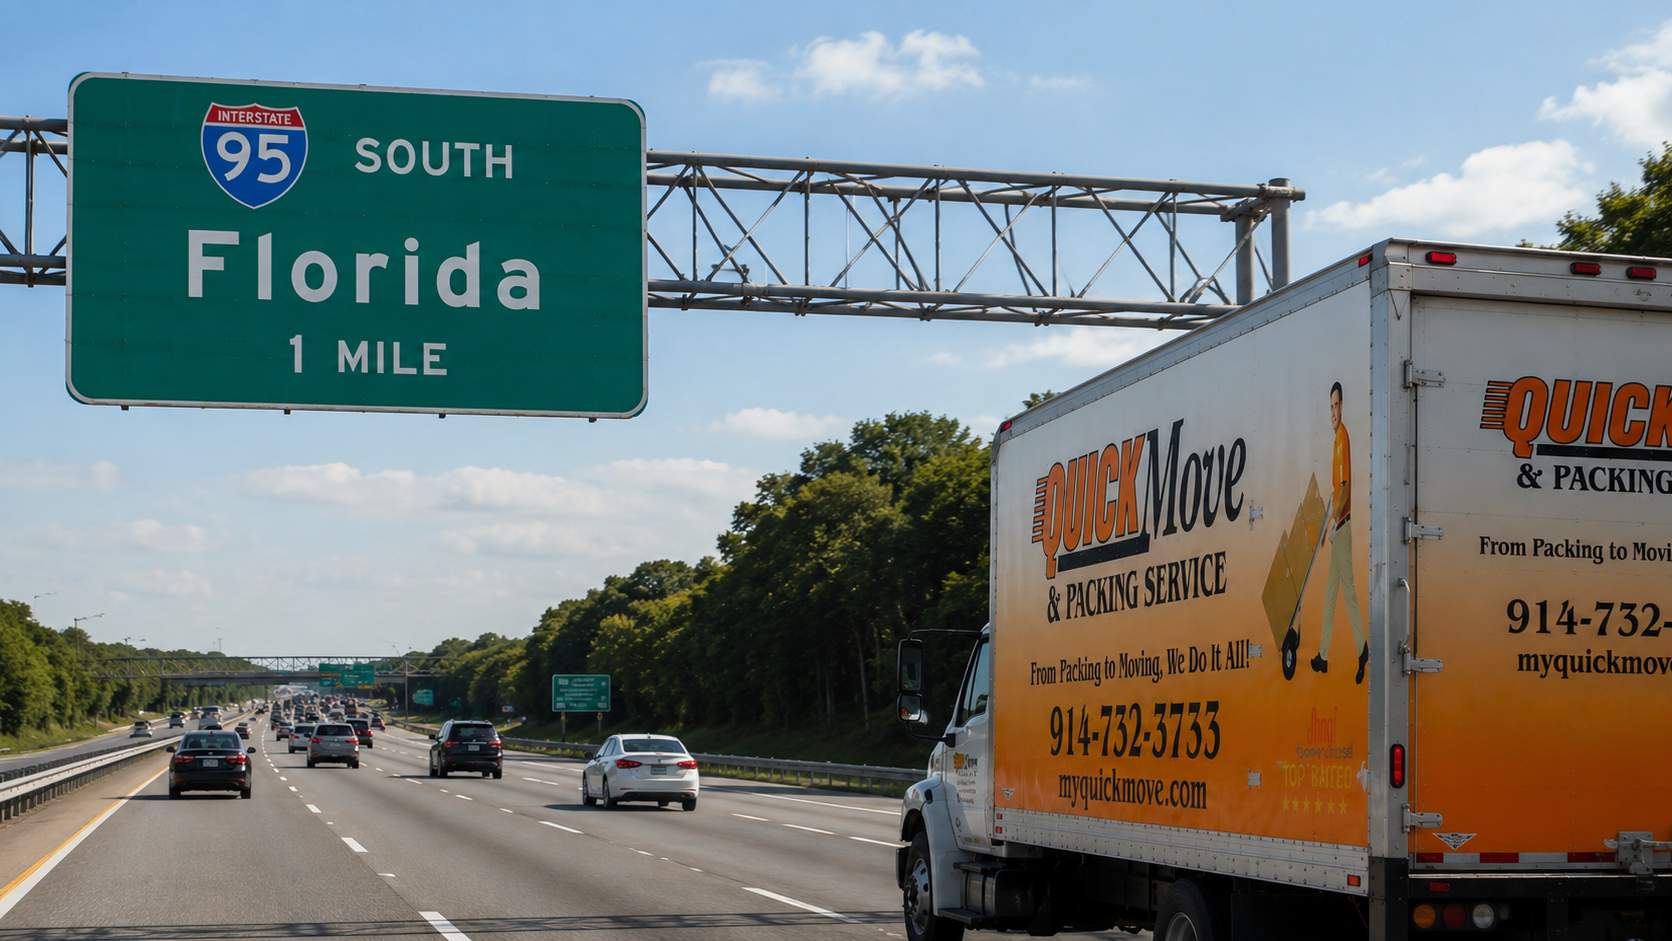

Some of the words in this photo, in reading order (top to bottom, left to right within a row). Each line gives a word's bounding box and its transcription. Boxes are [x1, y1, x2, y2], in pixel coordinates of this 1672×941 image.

[218, 110, 292, 125] INTERSTATE
[216, 131, 291, 184] 95
[355, 137, 513, 179] SOUTH
[188, 229, 541, 310] Florida
[289, 334, 302, 373] 1
[338, 340, 448, 376] MILE
[1516, 463, 1543, 489] &
[1552, 465, 1672, 495] PACKING
[1479, 536, 1527, 557] From
[1532, 538, 1604, 565] Packing
[1609, 541, 1628, 560] to
[1047, 585, 1061, 623] &
[1066, 571, 1139, 620] PACKING
[1144, 551, 1228, 607] SERVICE
[1030, 662, 1057, 686] From
[1060, 656, 1101, 687] Packing
[1104, 655, 1116, 680] to
[1118, 650, 1163, 683] Moving,
[1166, 647, 1185, 675] We
[1188, 646, 1207, 673] Do
[1211, 643, 1222, 671] It
[1225, 639, 1250, 670] All!
[1517, 649, 1672, 680] myquickmov
[1050, 700, 1221, 760] 914-732-3733
[1058, 768, 1208, 811] myquickmove.com
